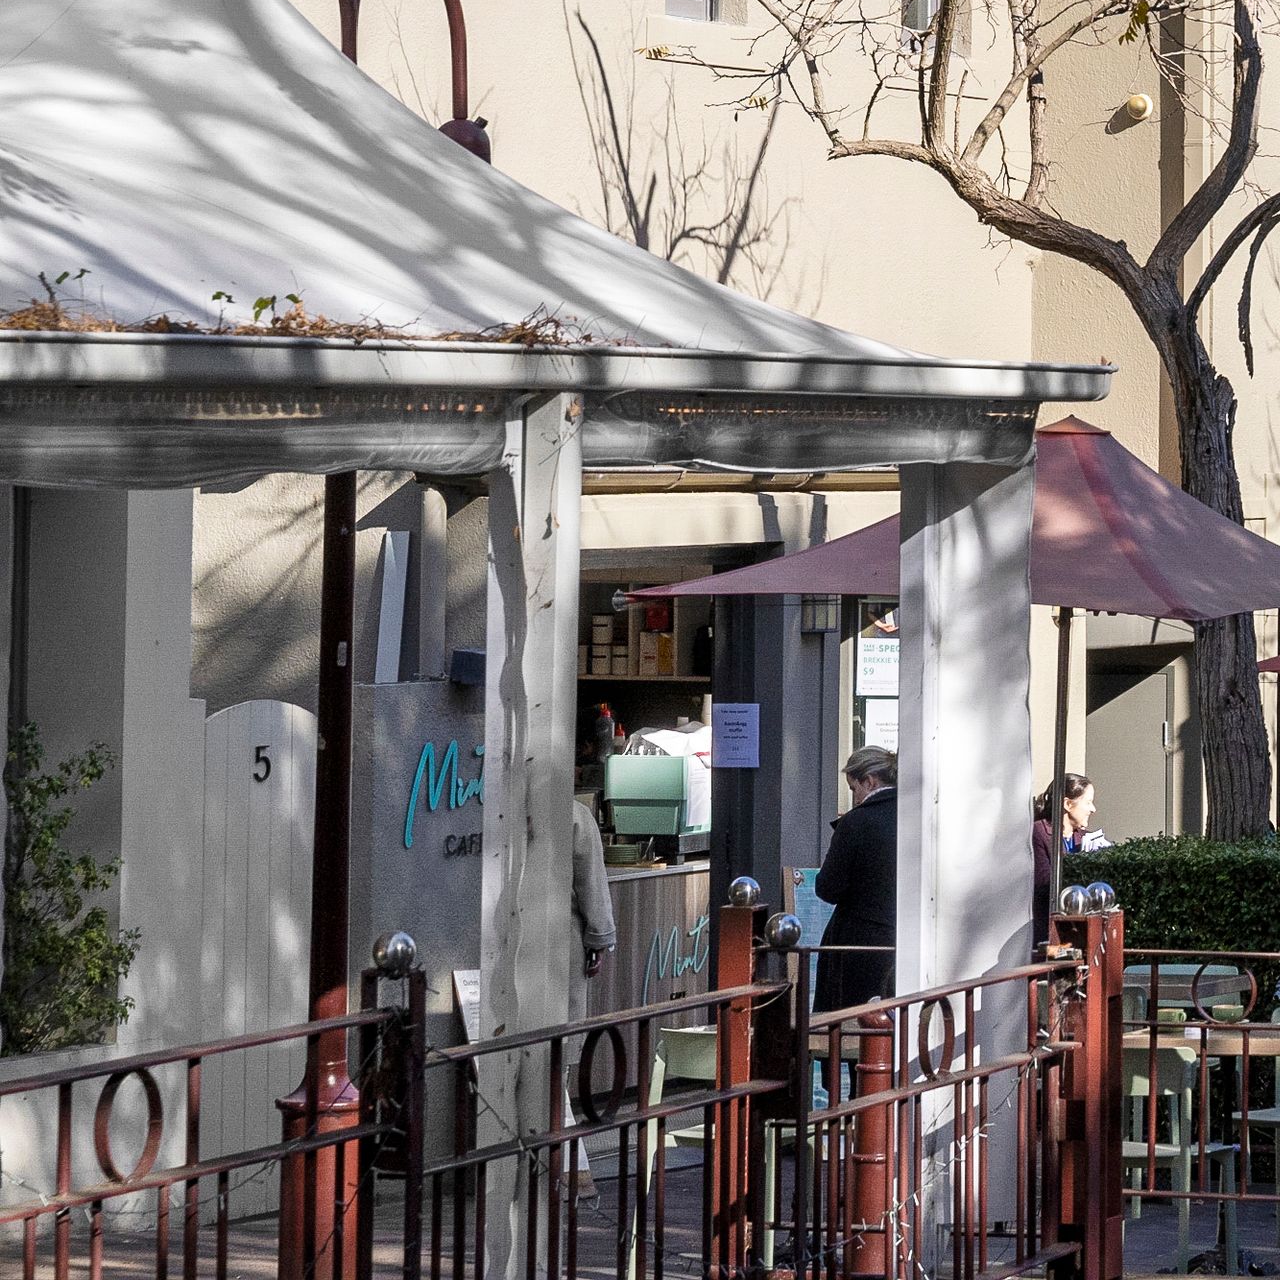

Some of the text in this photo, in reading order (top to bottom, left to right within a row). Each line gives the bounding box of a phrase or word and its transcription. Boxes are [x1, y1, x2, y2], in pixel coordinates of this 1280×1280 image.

[863, 667, 875, 676] $9
[253, 745, 271, 782] 5
[642, 915, 709, 1007] Mint
